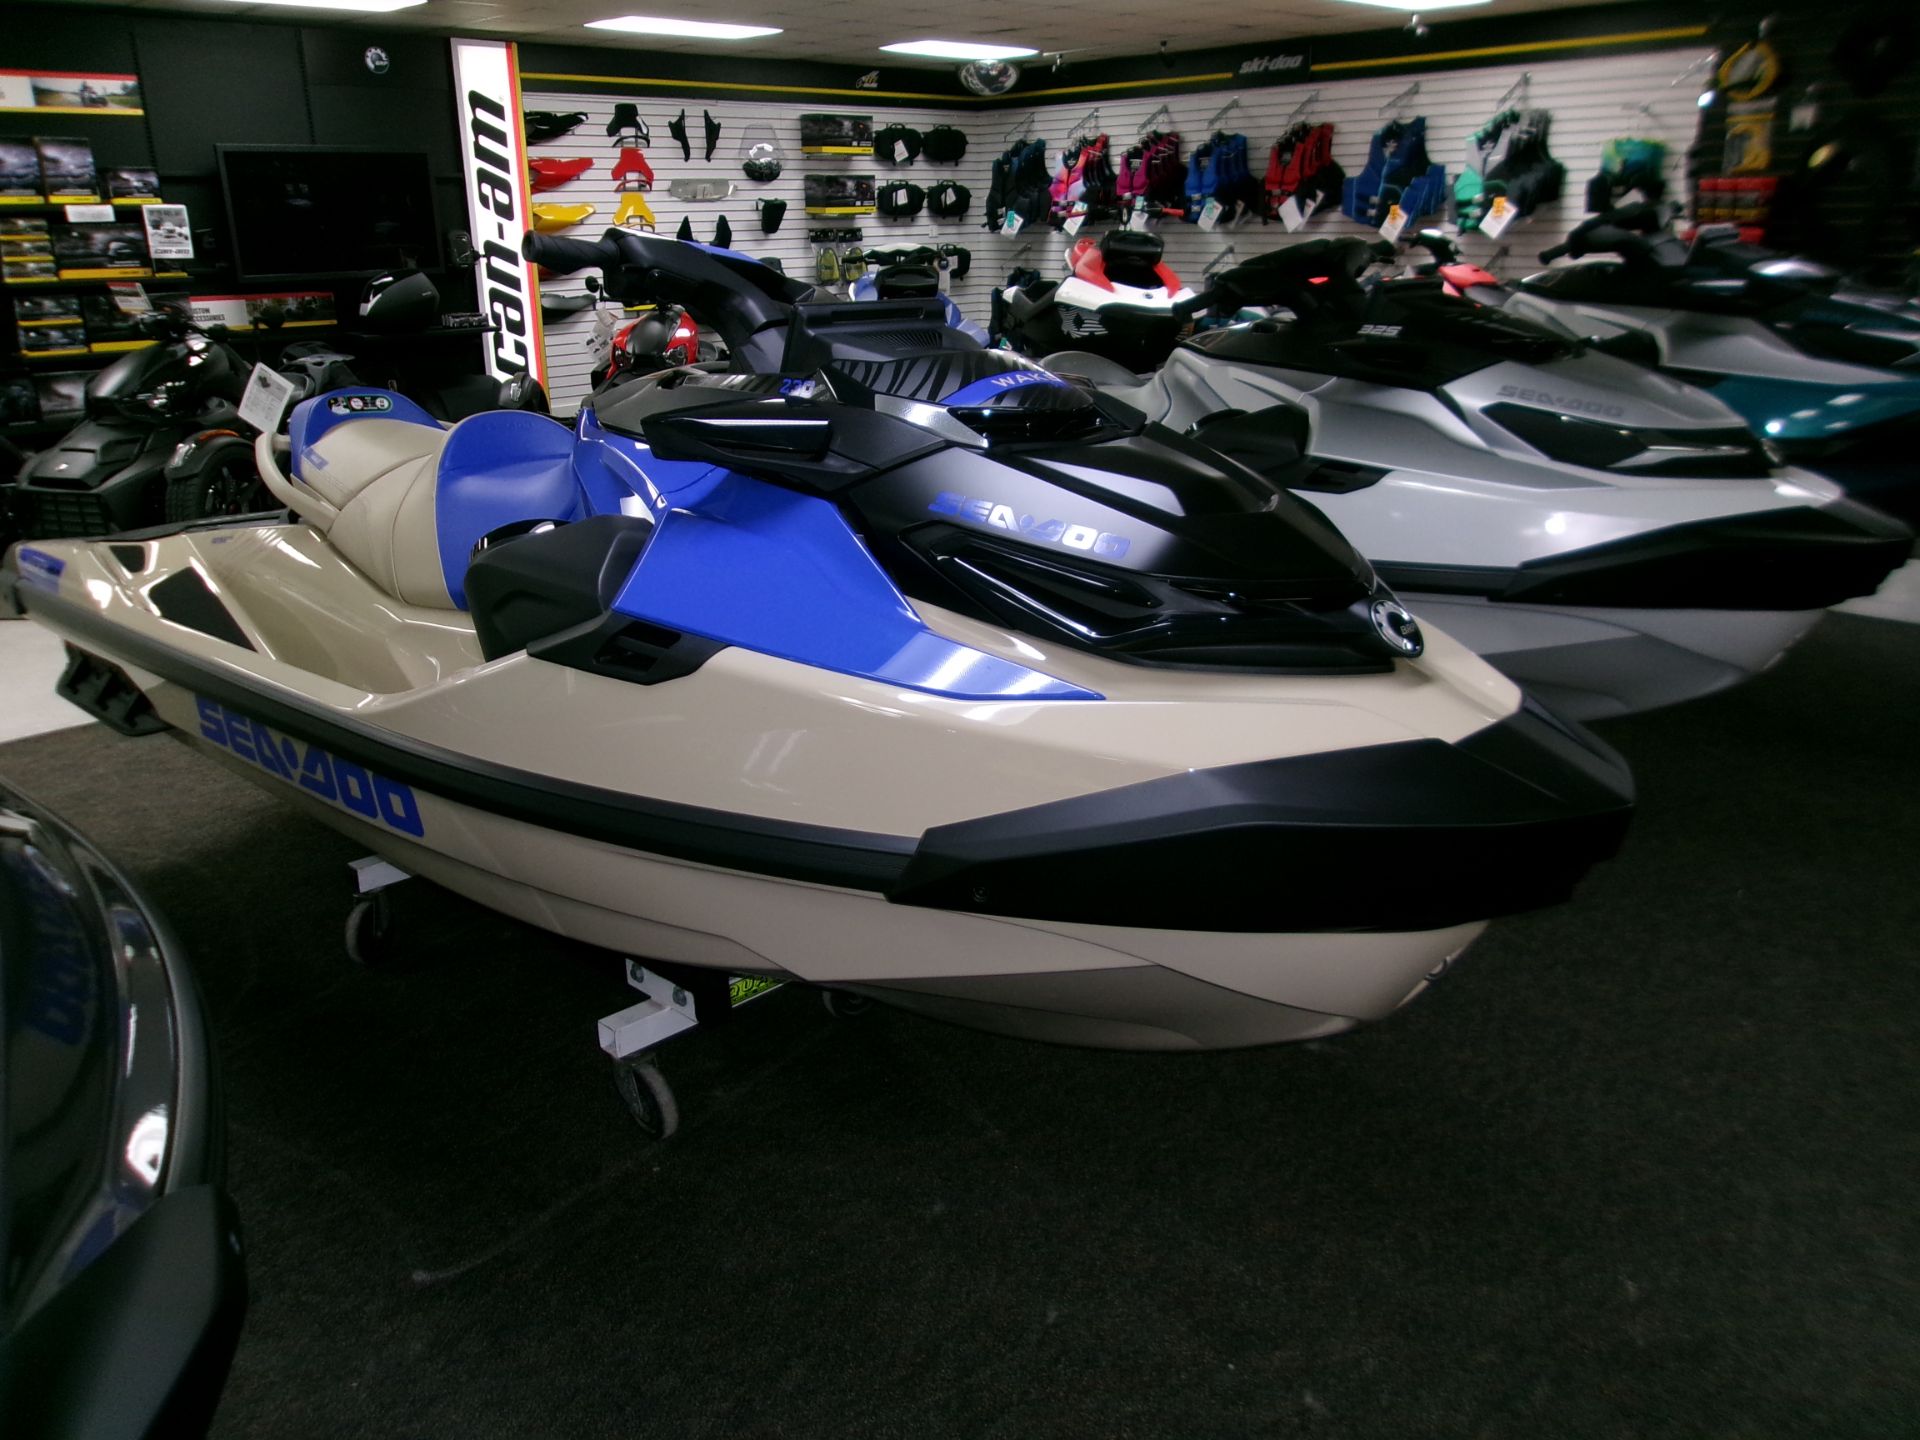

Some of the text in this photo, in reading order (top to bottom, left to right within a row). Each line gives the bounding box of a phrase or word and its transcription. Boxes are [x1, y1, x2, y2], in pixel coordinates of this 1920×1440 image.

[1239, 54, 1303, 74] ski-doo
[468, 90, 530, 378] can-am
[779, 378, 816, 398] 230
